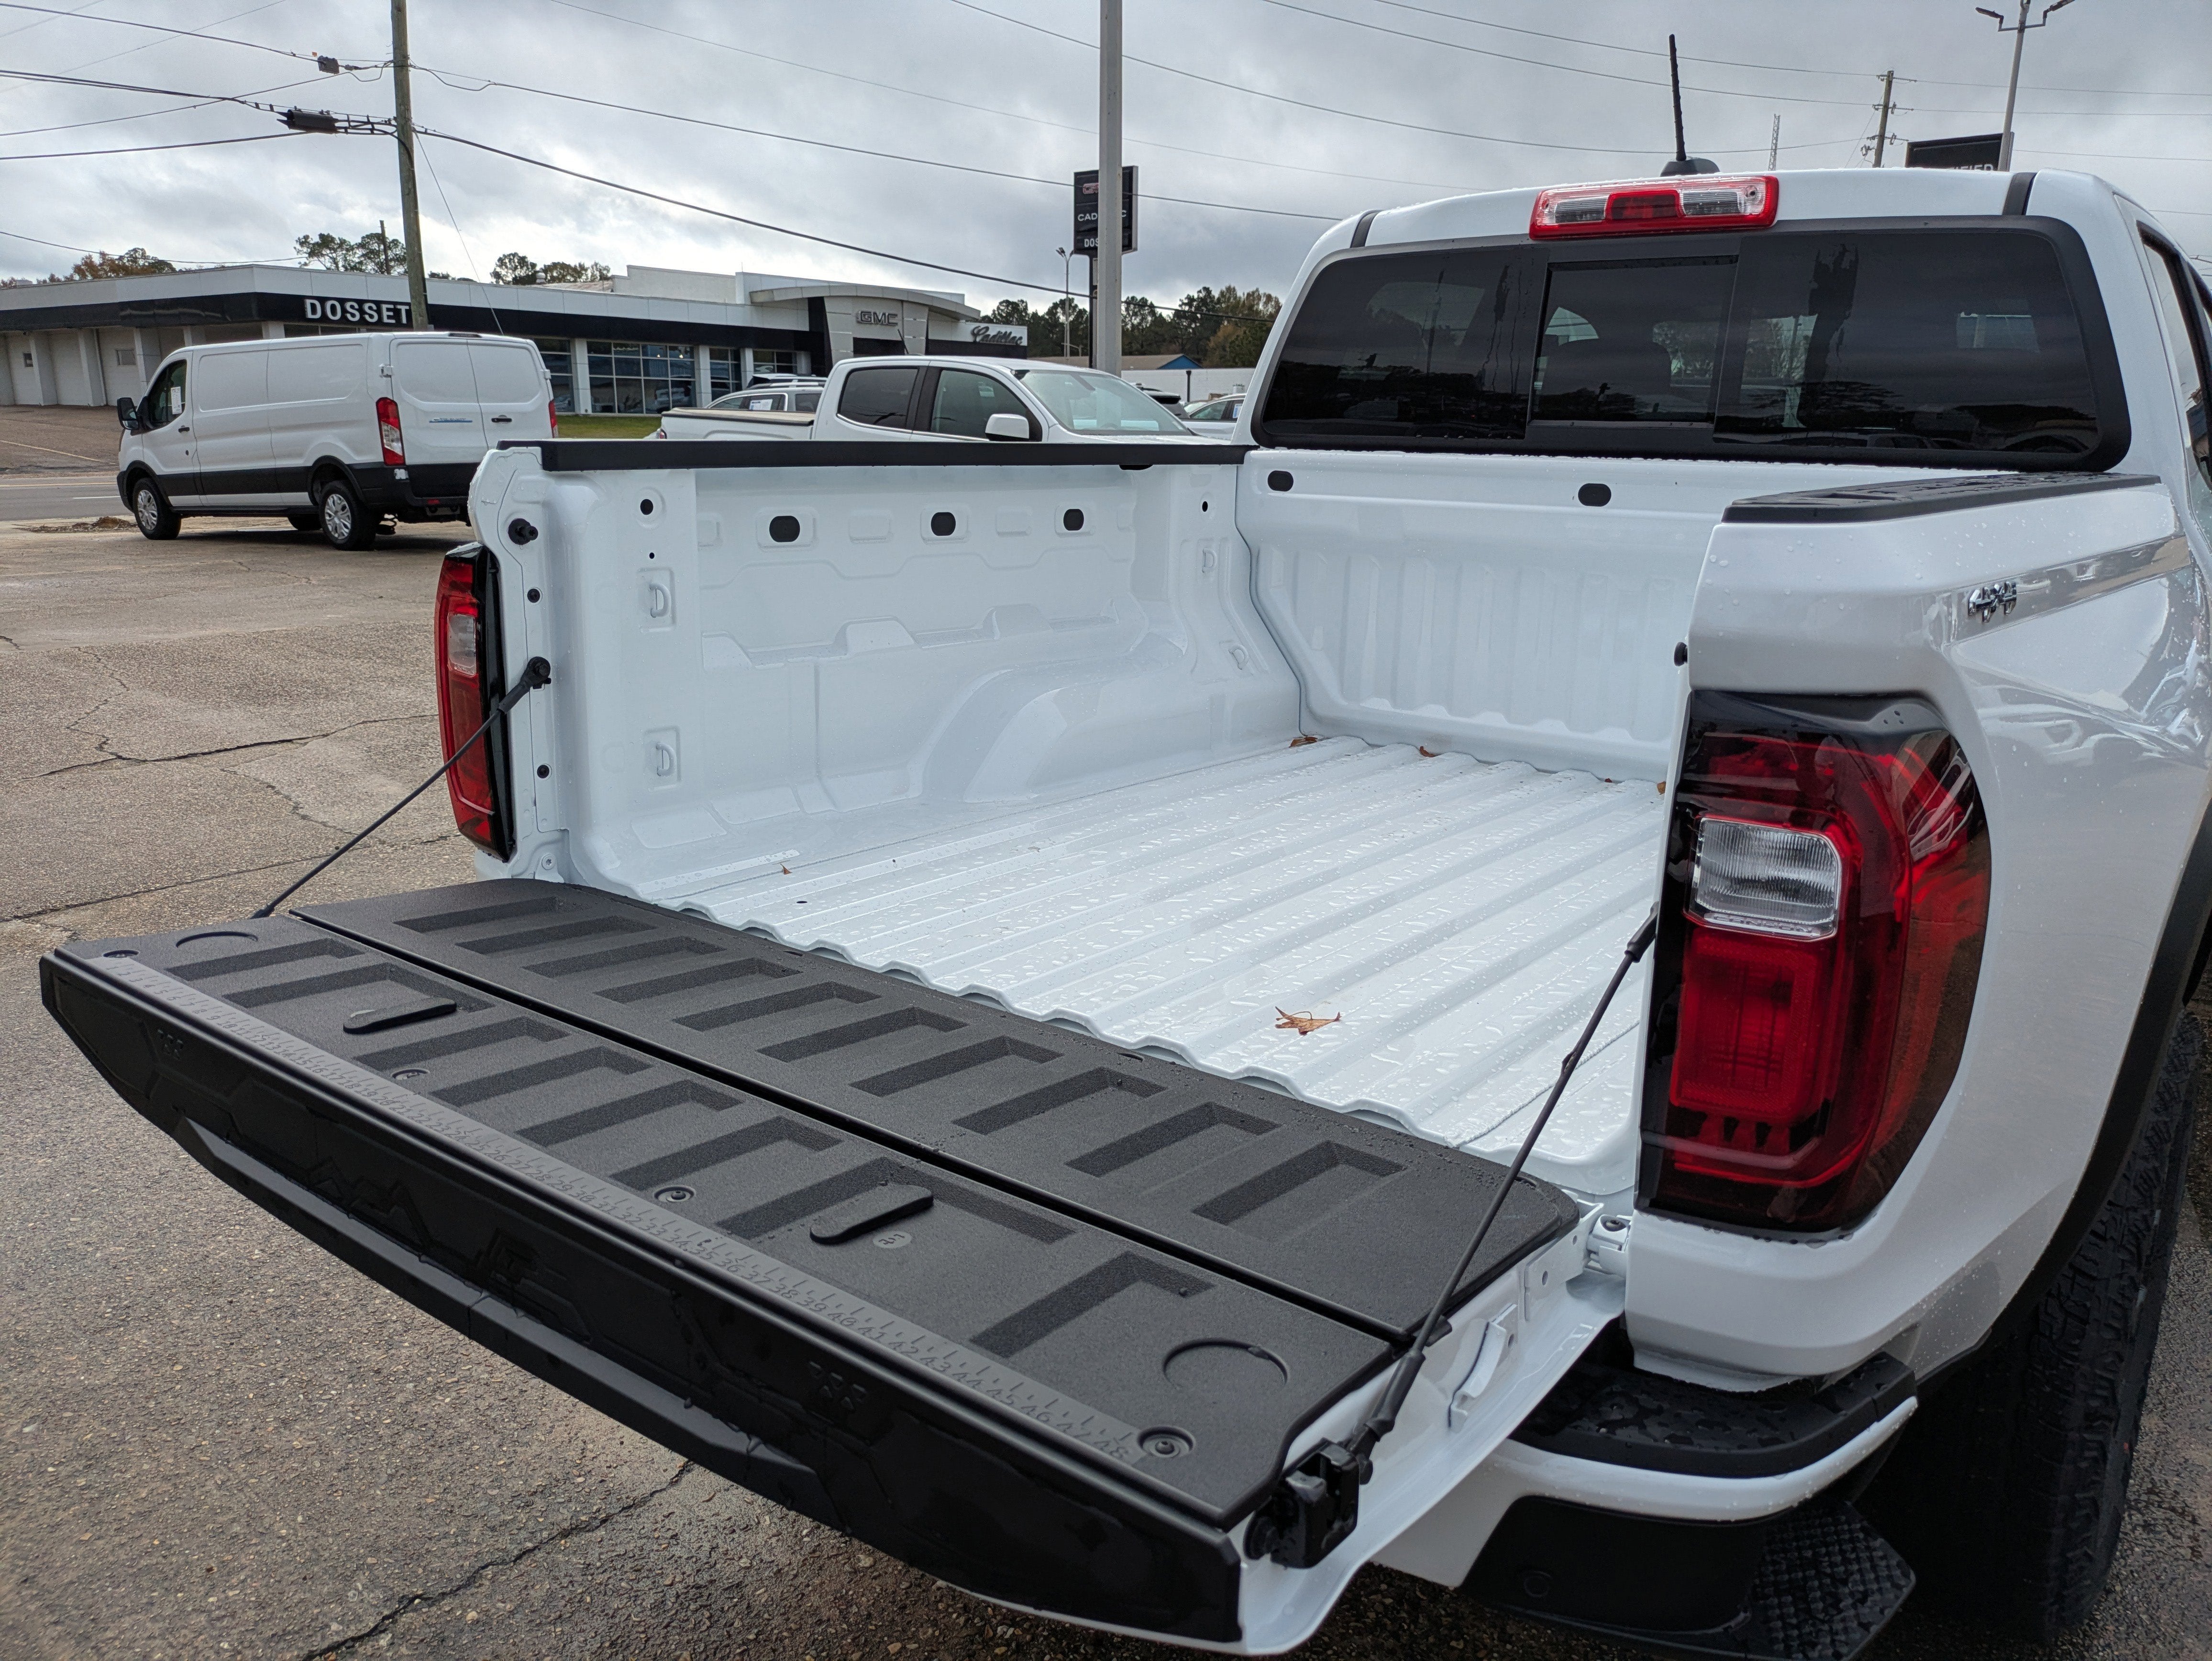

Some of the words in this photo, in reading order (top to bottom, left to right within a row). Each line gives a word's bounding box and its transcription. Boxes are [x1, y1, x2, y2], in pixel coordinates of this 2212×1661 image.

[1077, 210, 1127, 221] CADC
[856, 311, 898, 326] GMC
[971, 326, 1023, 344] Cadillac
